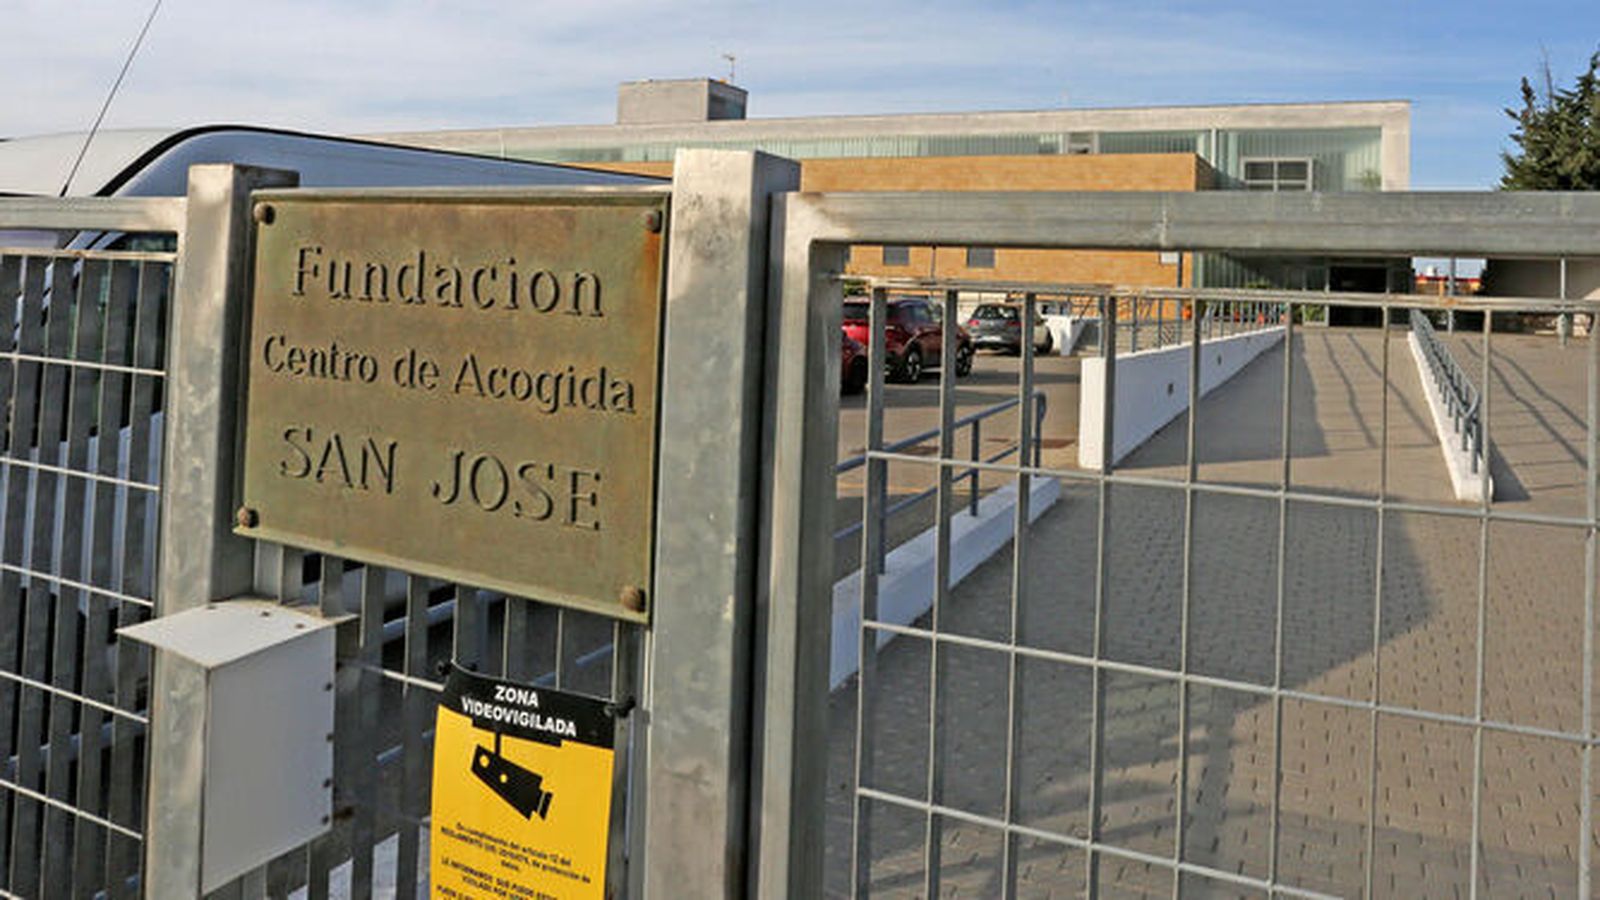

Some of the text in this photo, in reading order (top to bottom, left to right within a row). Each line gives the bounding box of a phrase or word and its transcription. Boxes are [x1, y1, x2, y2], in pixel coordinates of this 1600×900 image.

[292, 245, 605, 319] Fundacion
[263, 335, 637, 415] Centro de Acogida
[280, 427, 602, 532] SAN JOSE
[461, 696, 577, 738] VIDEOVIGILADA
[494, 685, 540, 708] ZONA
